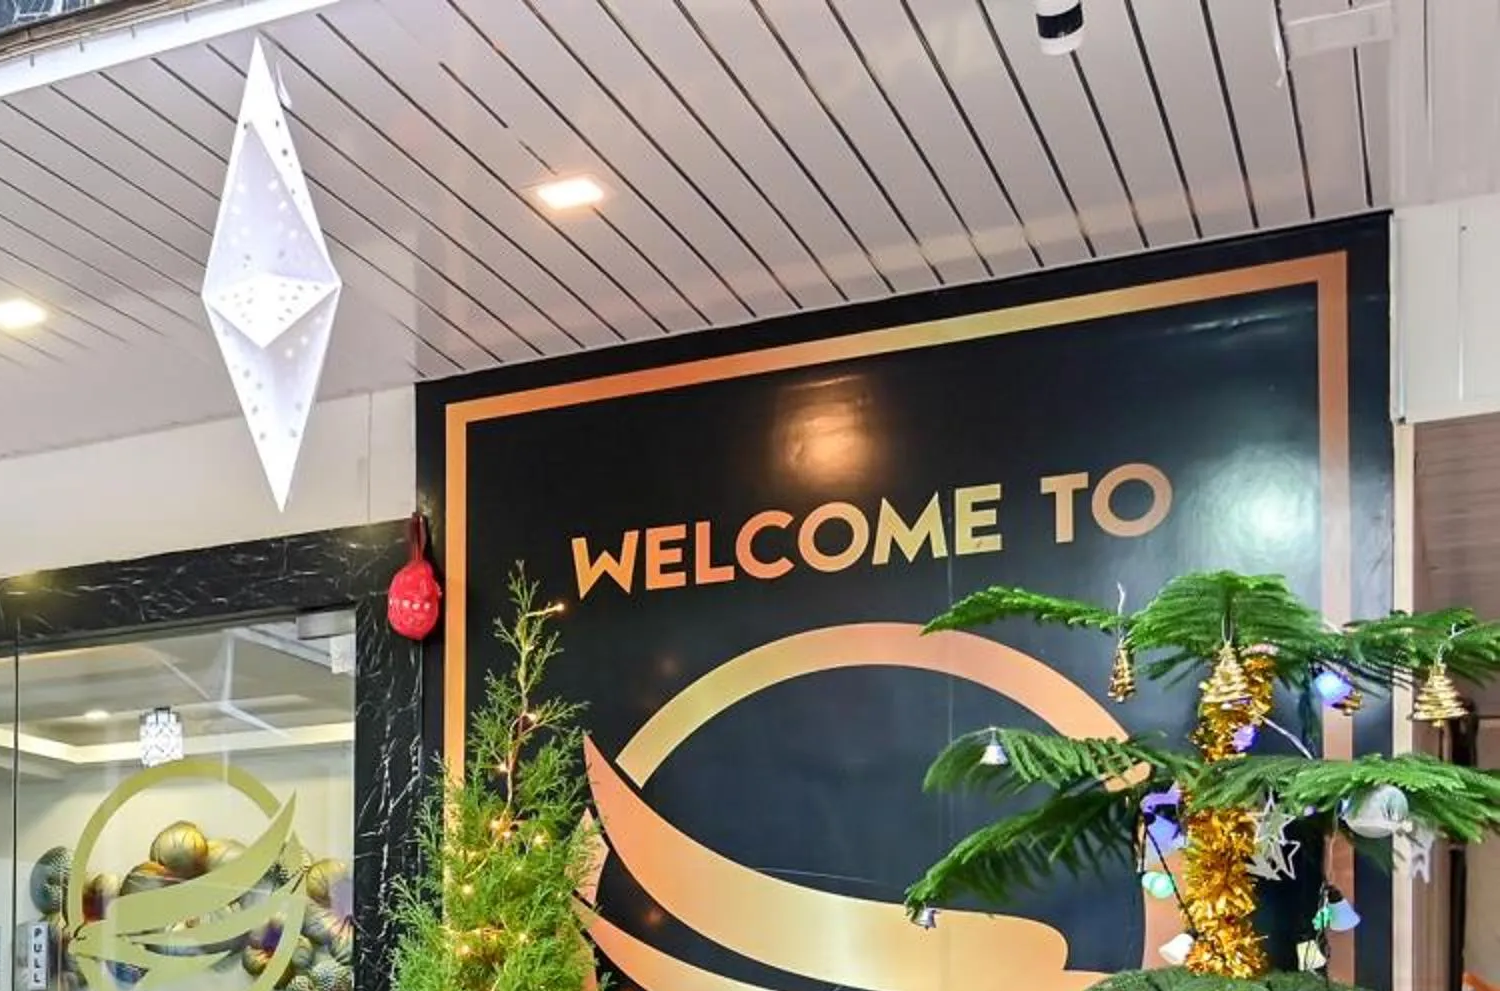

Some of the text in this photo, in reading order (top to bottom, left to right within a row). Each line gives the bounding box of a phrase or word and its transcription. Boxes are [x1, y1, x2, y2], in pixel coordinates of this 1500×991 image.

[572, 462, 1173, 599] WELCOME TO
[33, 927, 43, 983] PULL
